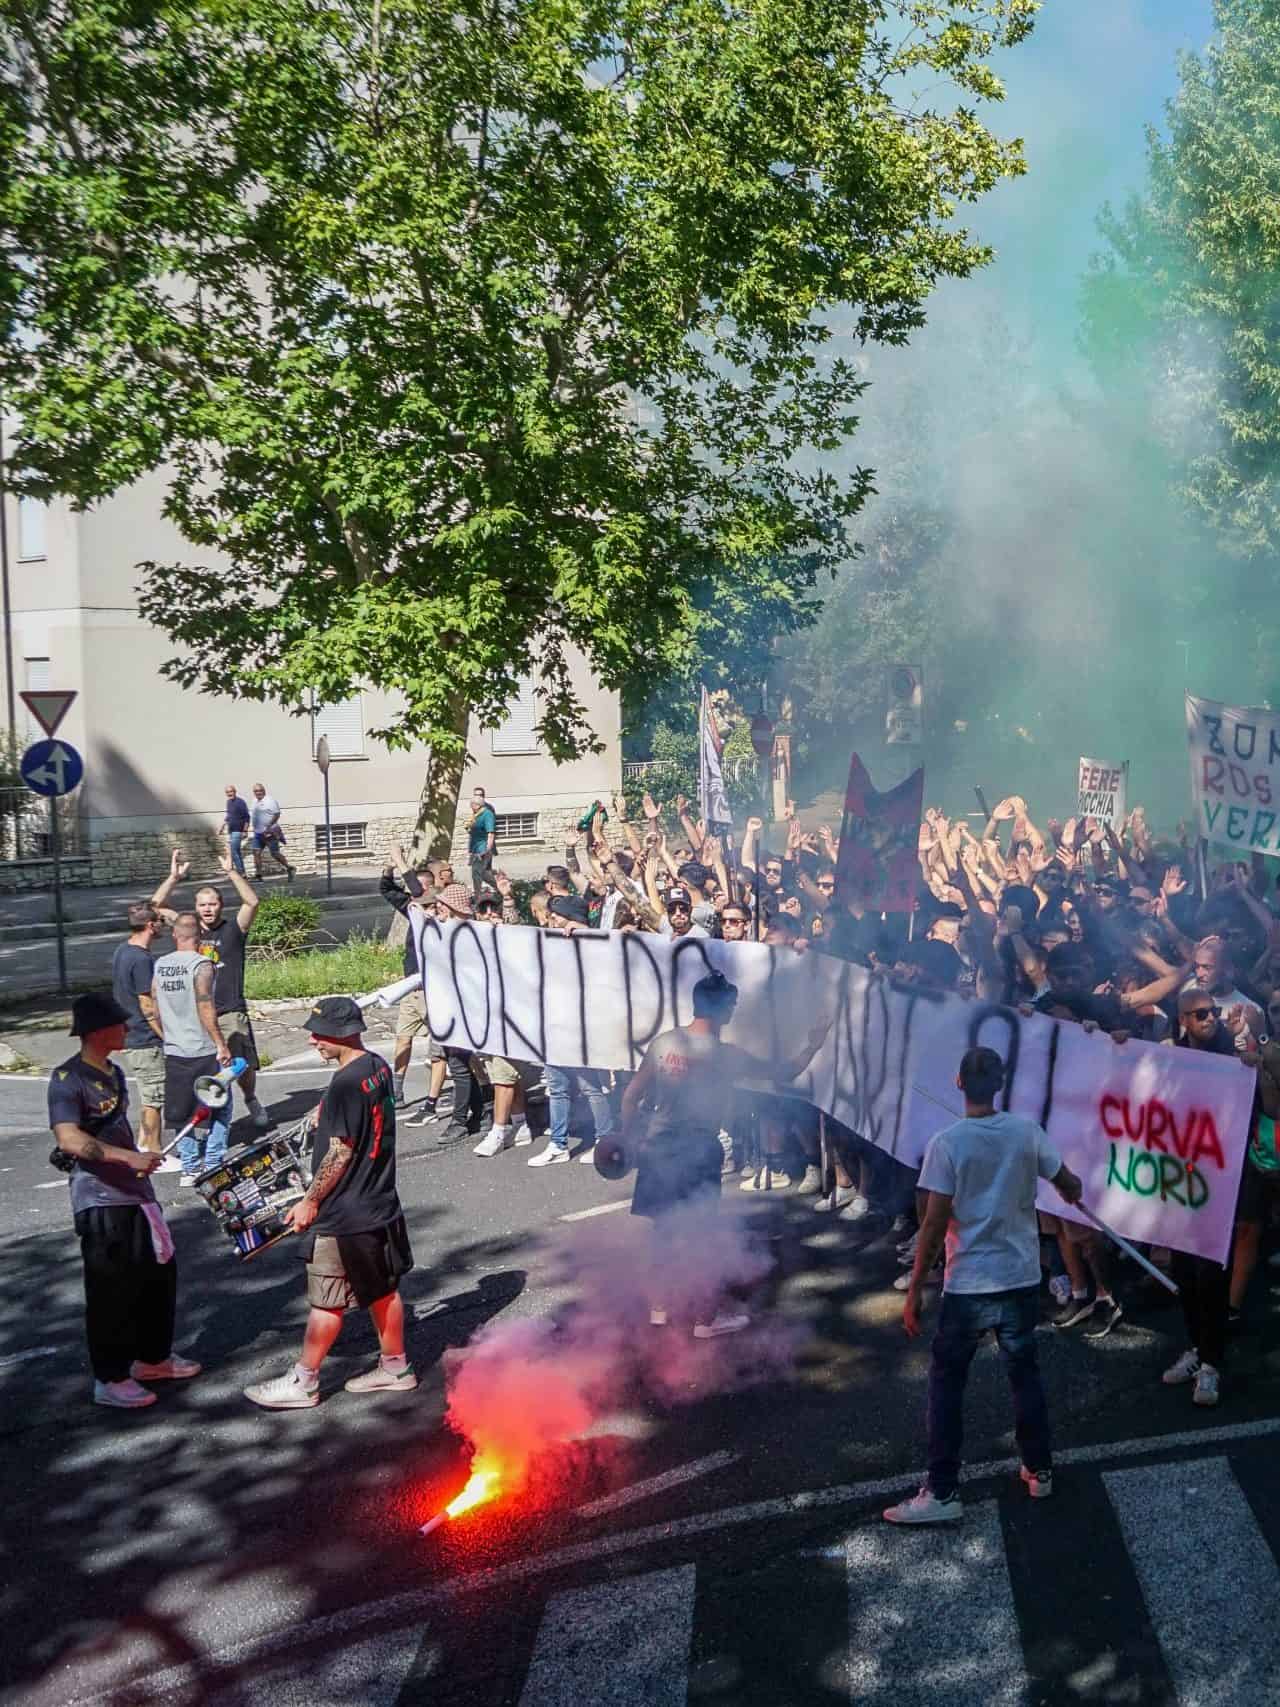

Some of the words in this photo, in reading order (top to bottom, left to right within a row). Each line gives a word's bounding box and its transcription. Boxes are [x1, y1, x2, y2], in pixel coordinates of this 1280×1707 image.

[1080, 766, 1121, 793] FERE
[1099, 1093, 1226, 1171] CURVA
[1106, 1142, 1210, 1212] NORD
